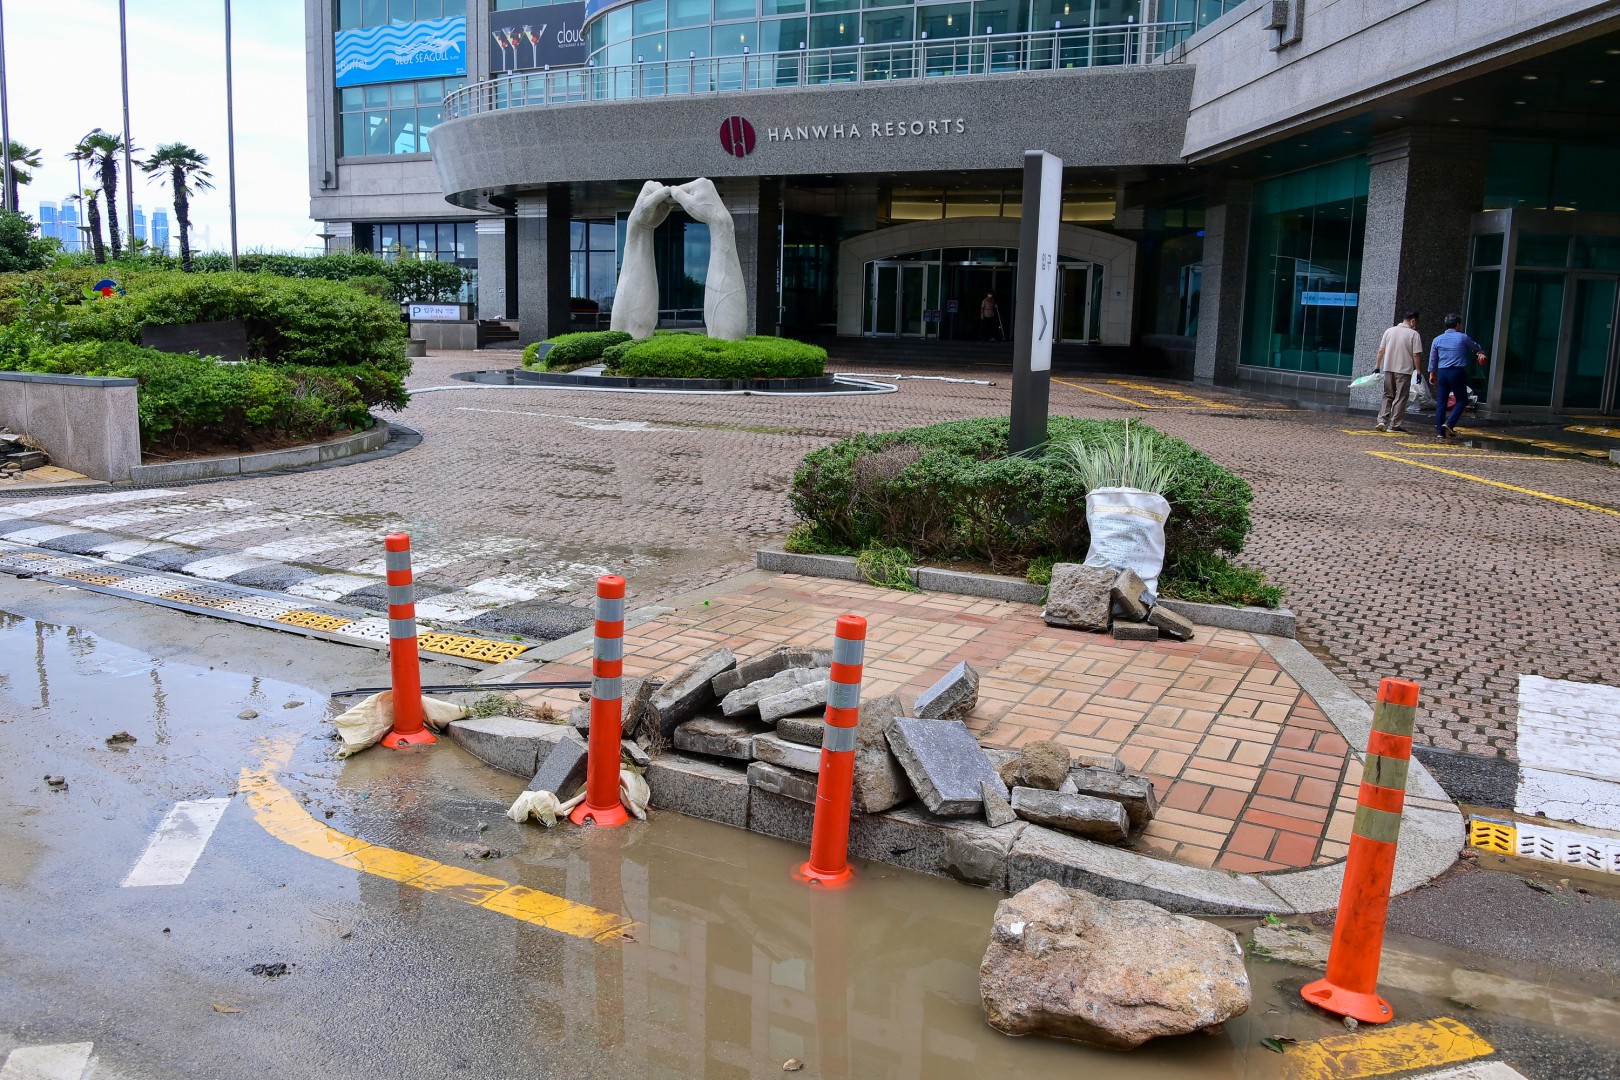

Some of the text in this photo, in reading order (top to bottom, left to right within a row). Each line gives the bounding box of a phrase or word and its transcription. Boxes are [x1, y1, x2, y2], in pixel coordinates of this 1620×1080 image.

[415, 50, 449, 63] SEAGULL
[768, 118, 966, 142] HANWHA RESORTS
[1041, 253, 1051, 271] 입구
[412, 306, 421, 317] P
